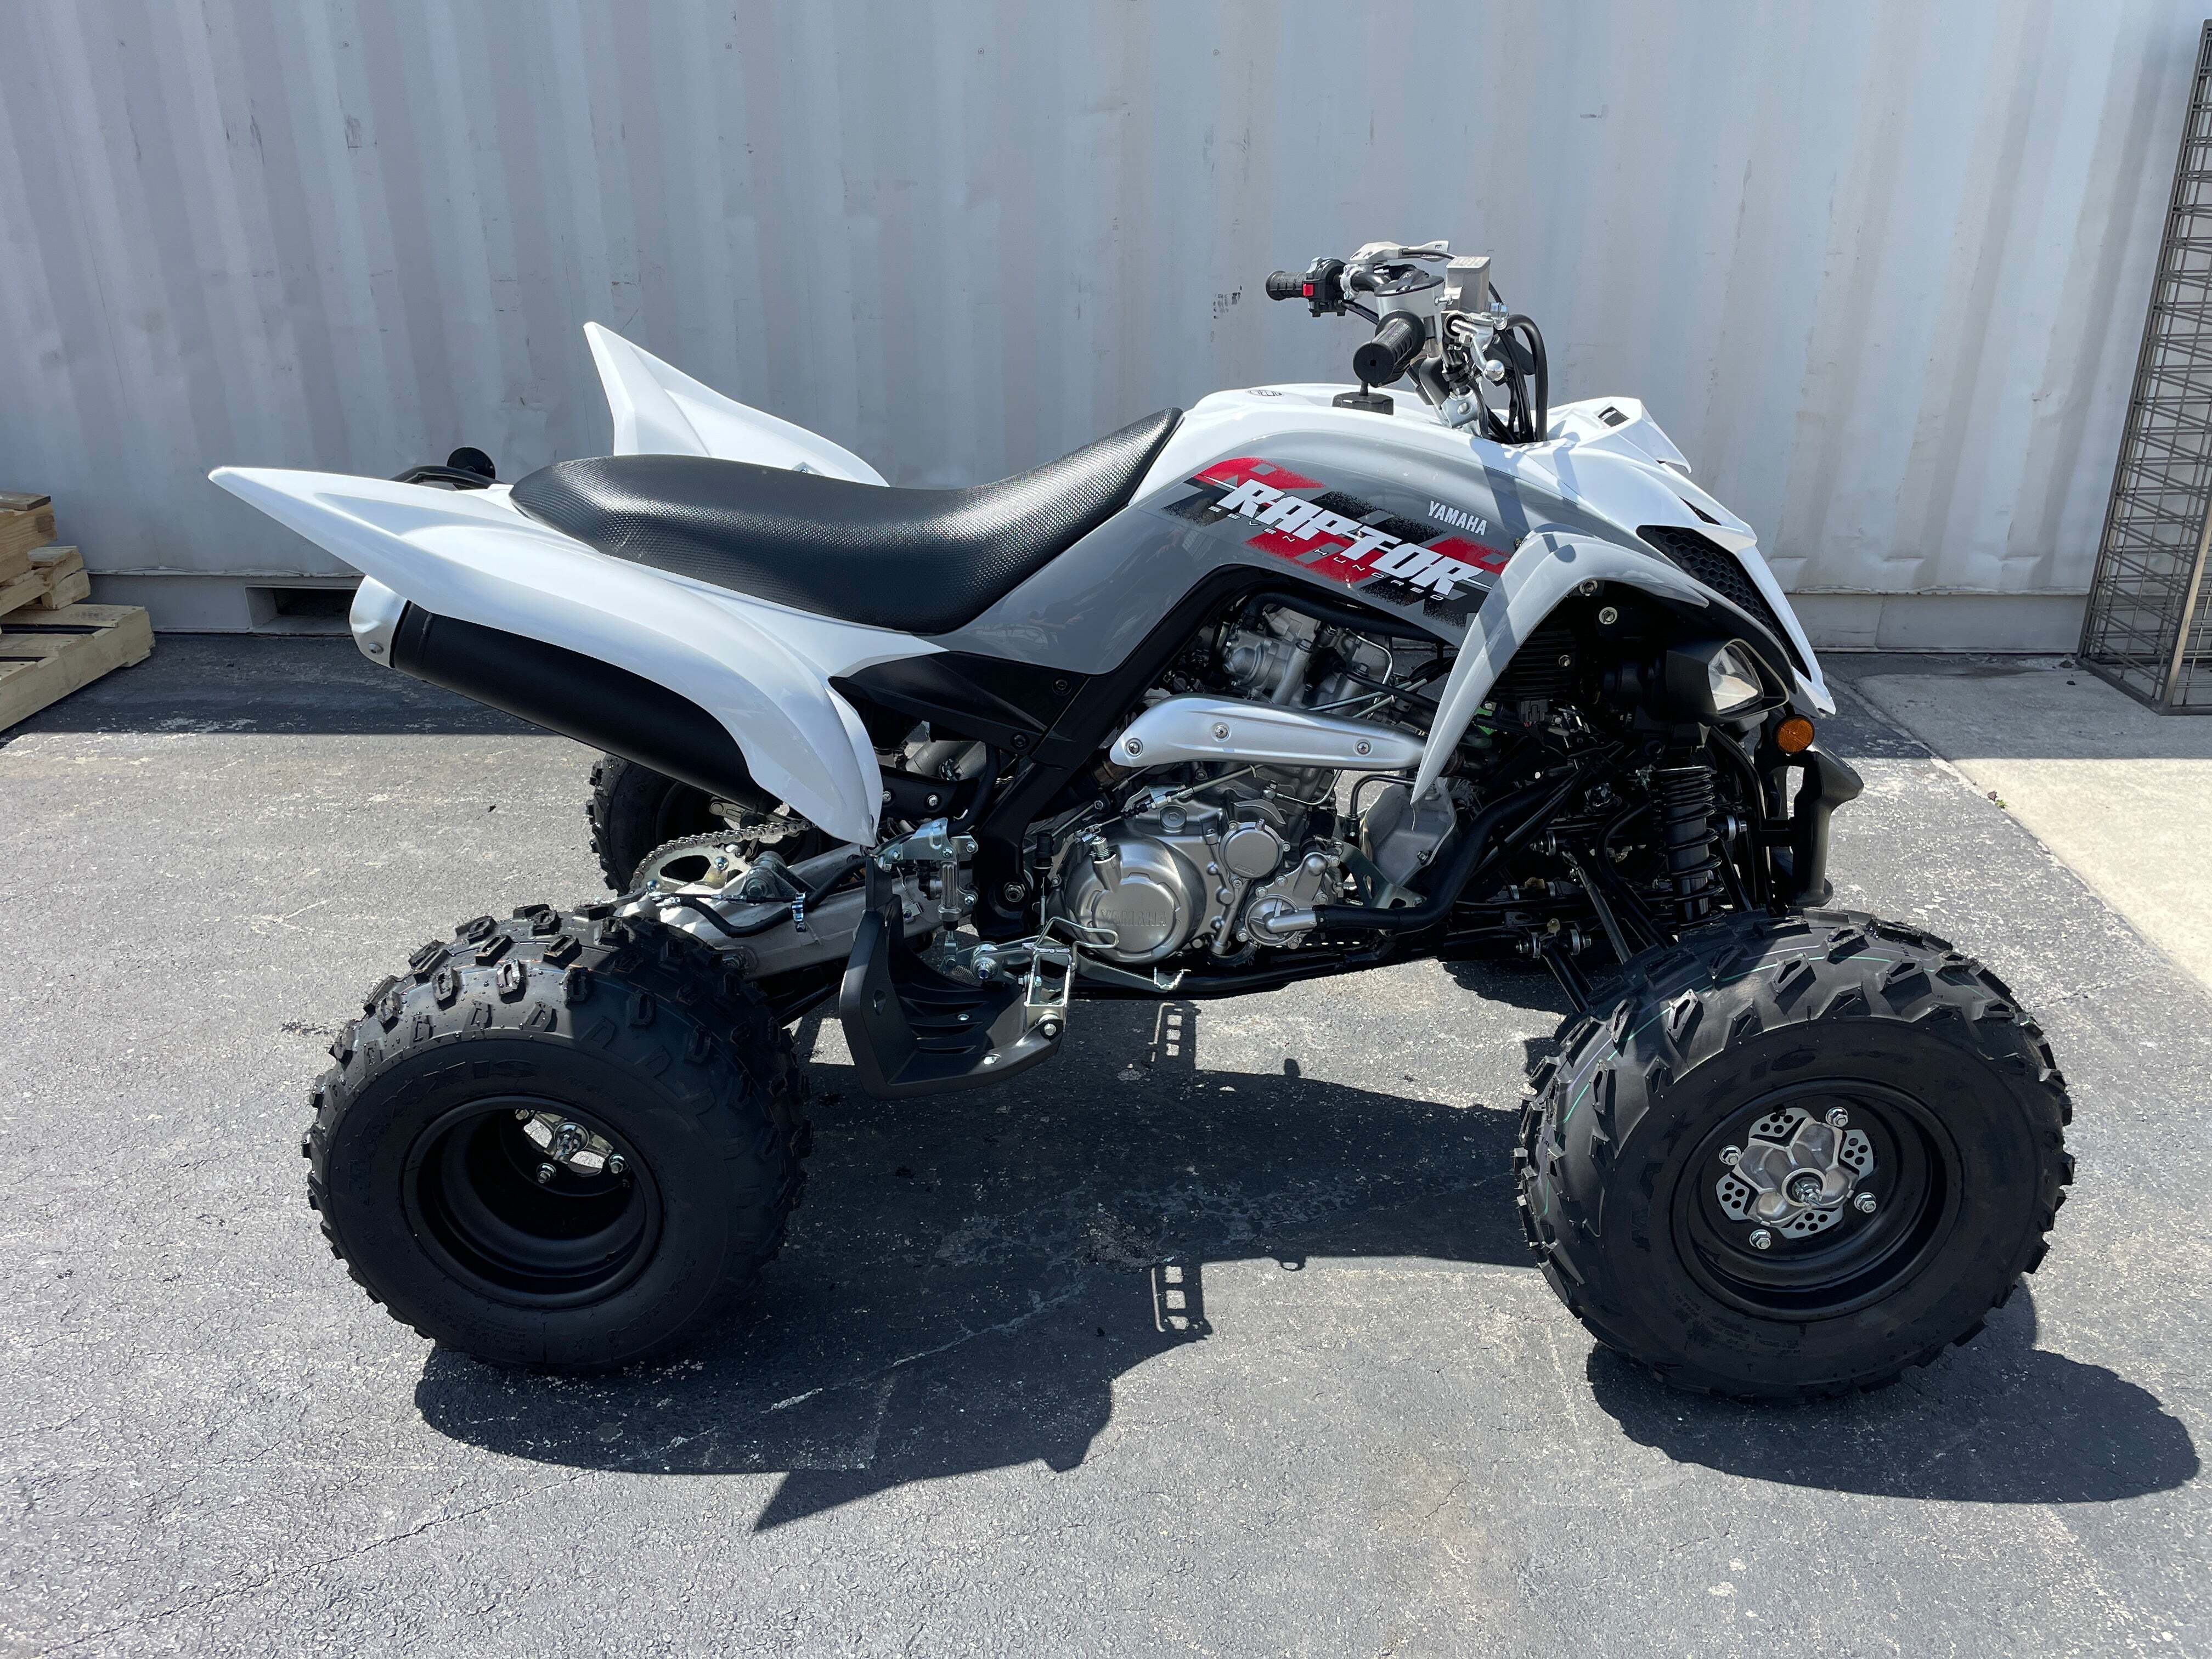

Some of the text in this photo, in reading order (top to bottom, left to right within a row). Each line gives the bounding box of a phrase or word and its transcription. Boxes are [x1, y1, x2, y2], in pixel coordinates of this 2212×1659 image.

[1215, 478, 1486, 596] RAPTOR
[1428, 500, 1487, 536] YAMAHA
[1209, 505, 1444, 601] SEVEN HUNDRED
[1101, 909, 1167, 927] YAMAHA
